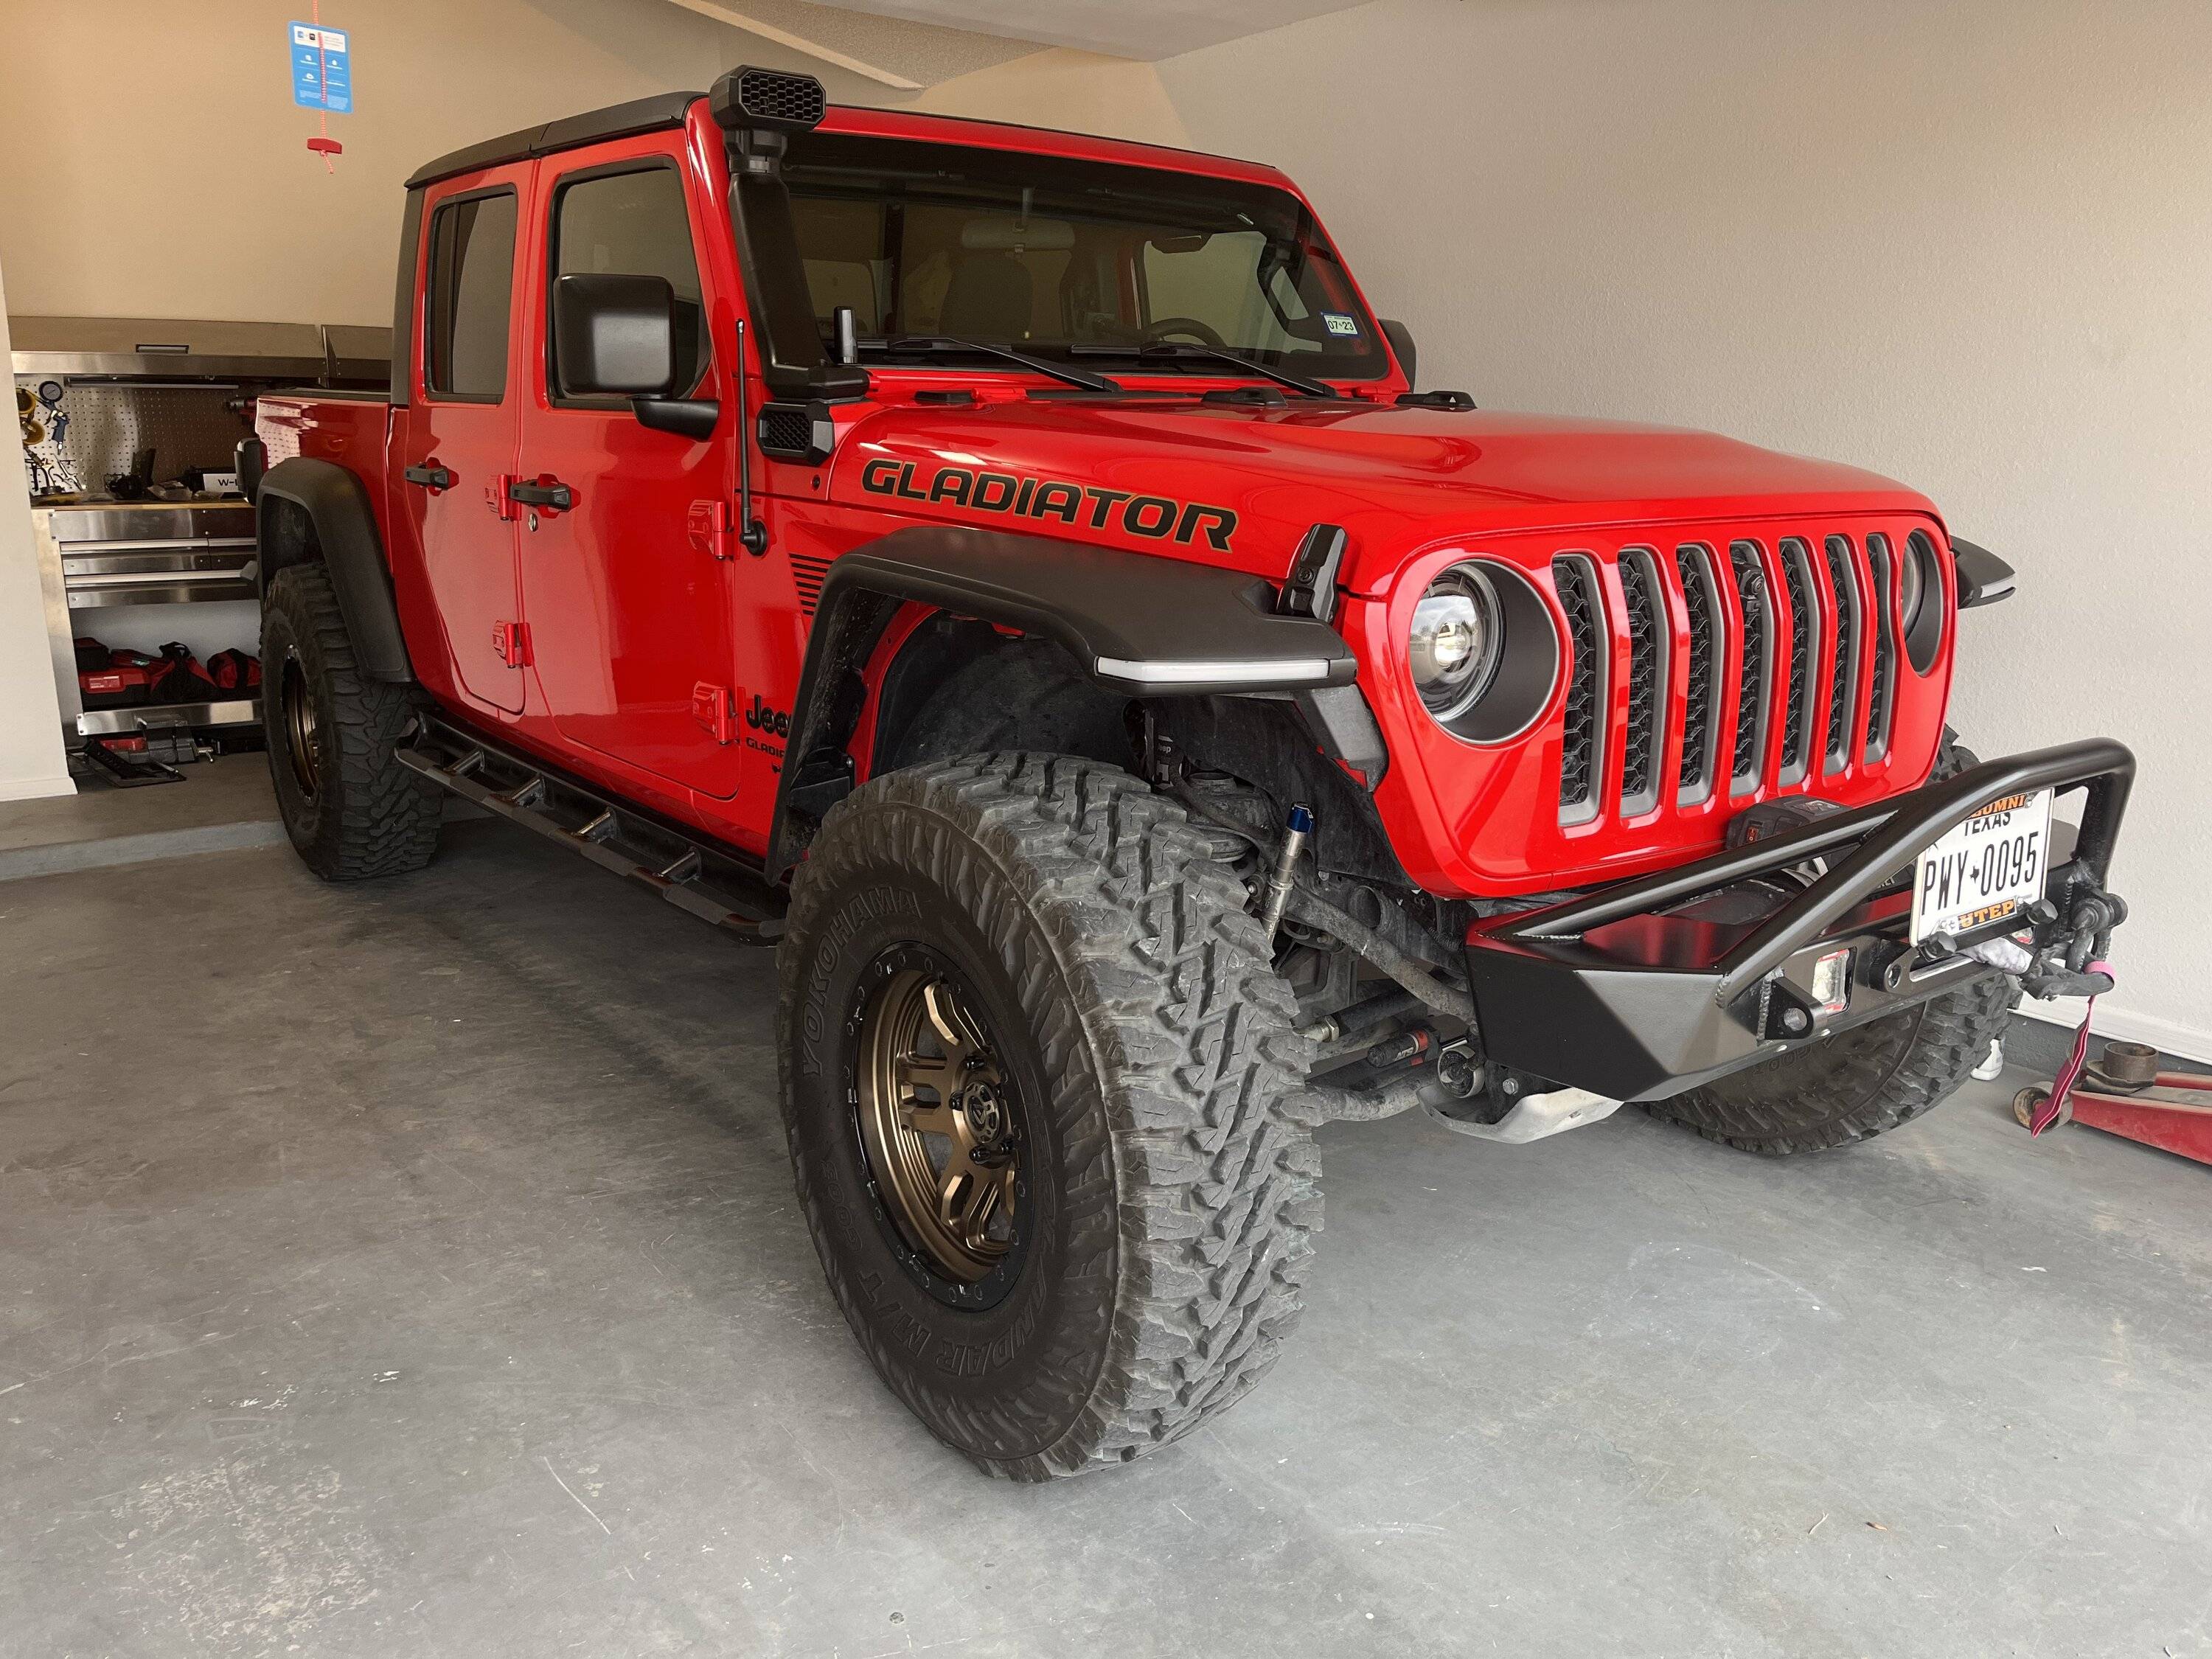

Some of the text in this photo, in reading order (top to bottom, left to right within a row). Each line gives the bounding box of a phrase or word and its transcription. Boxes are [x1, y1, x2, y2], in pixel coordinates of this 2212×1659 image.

[861, 456, 1239, 554] GLADIATOR
[745, 694, 792, 738] Jee
[1964, 811, 2011, 837] TEXAS
[1970, 793, 2026, 818] UMNI
[1958, 898, 2016, 929] UTEP
[802, 885, 922, 1077] YOKOHAMA
